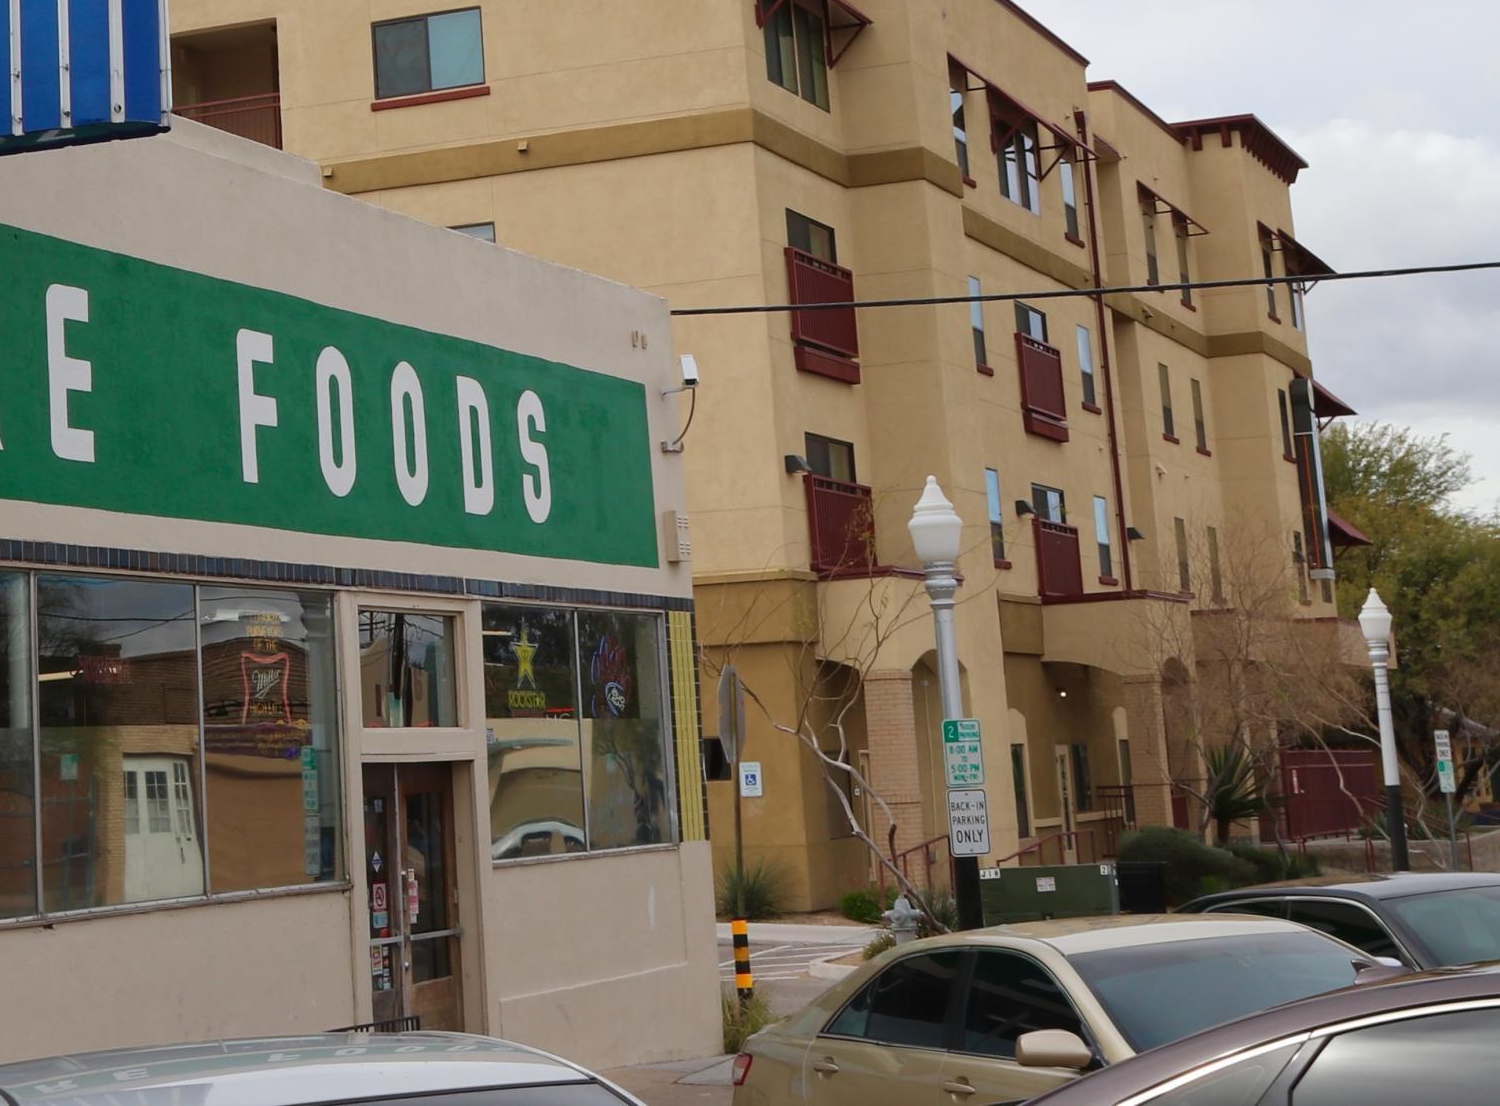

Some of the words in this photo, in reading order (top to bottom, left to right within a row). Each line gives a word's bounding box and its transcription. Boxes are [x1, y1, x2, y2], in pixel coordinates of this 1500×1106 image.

[236, 328, 552, 523] FOODS
[947, 725, 955, 739] 2
[950, 800, 985, 812] BACK-IN
[952, 814, 986, 825] PARKING
[956, 829, 984, 844] ONLY
